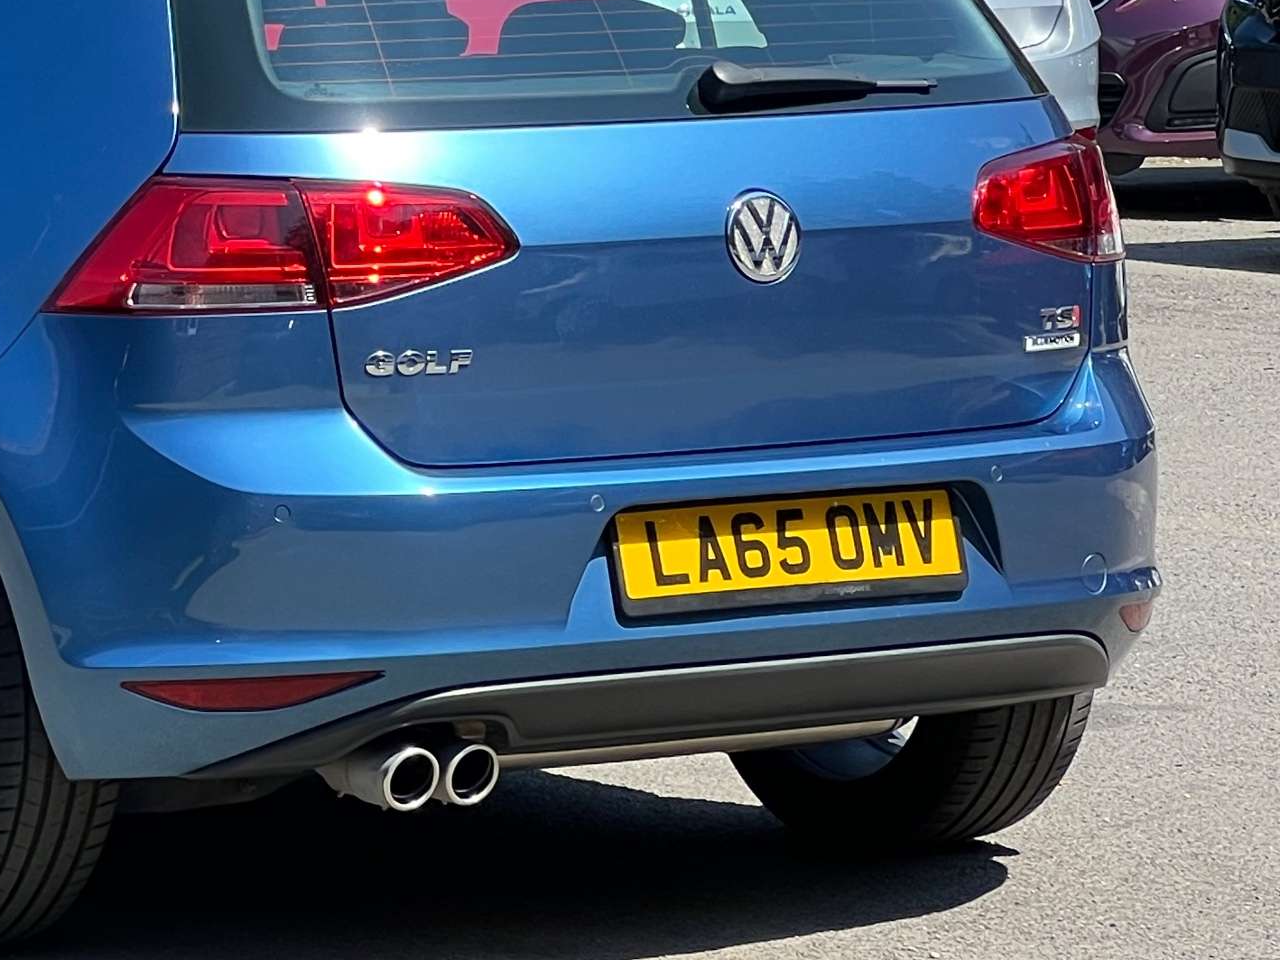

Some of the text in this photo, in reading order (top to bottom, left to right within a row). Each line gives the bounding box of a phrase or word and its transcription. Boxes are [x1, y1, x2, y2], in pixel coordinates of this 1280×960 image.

[365, 349, 473, 377] GOLF
[644, 497, 933, 587] LA65 OMV
